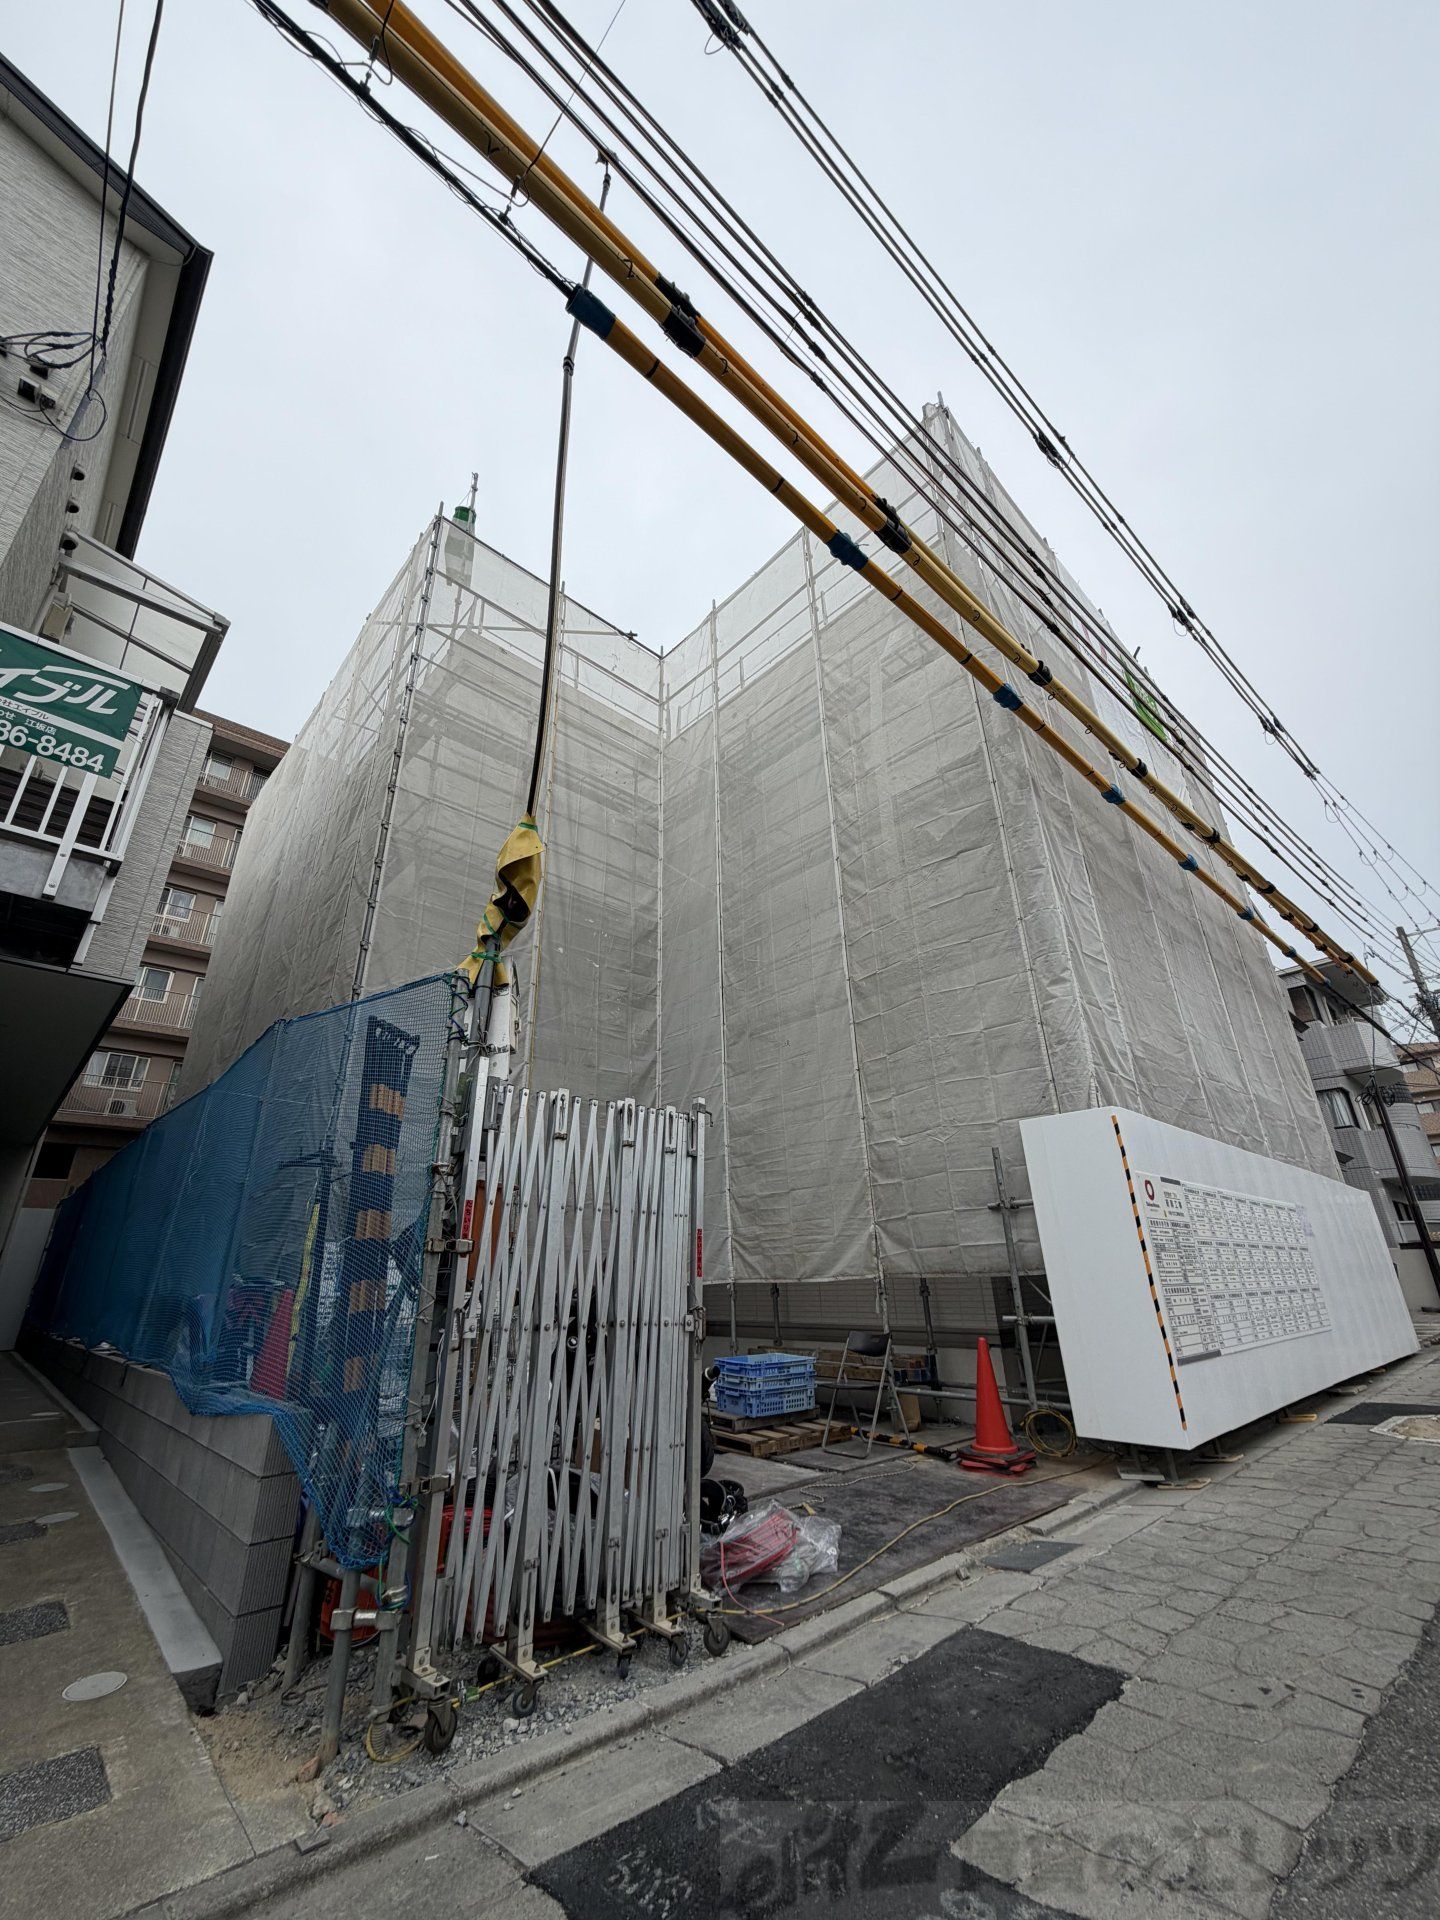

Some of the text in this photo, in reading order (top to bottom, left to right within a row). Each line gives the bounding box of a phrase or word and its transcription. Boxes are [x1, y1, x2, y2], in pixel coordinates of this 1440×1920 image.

[0, 698, 49, 720] 社エイブル
[24, 718, 57, 735] 江坂店
